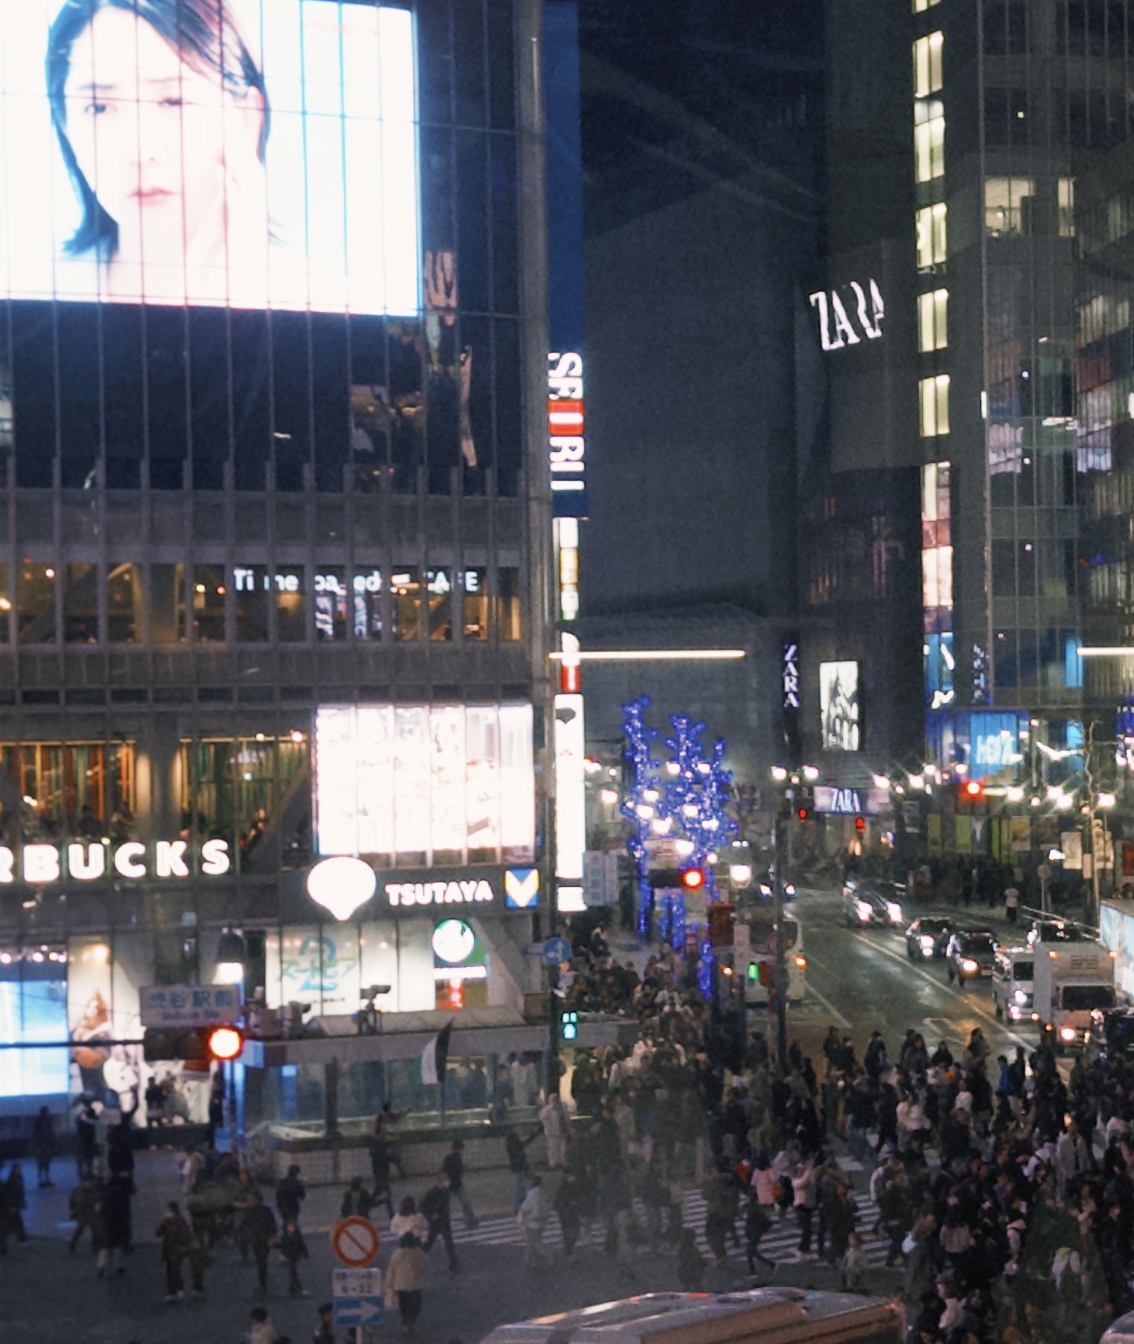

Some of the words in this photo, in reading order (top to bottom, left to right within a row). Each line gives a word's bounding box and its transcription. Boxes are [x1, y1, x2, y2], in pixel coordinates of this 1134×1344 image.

[809, 277, 885, 351] ZARA
[783, 643, 799, 708] ZARA
[385, 880, 493, 906] TSUTAYA
